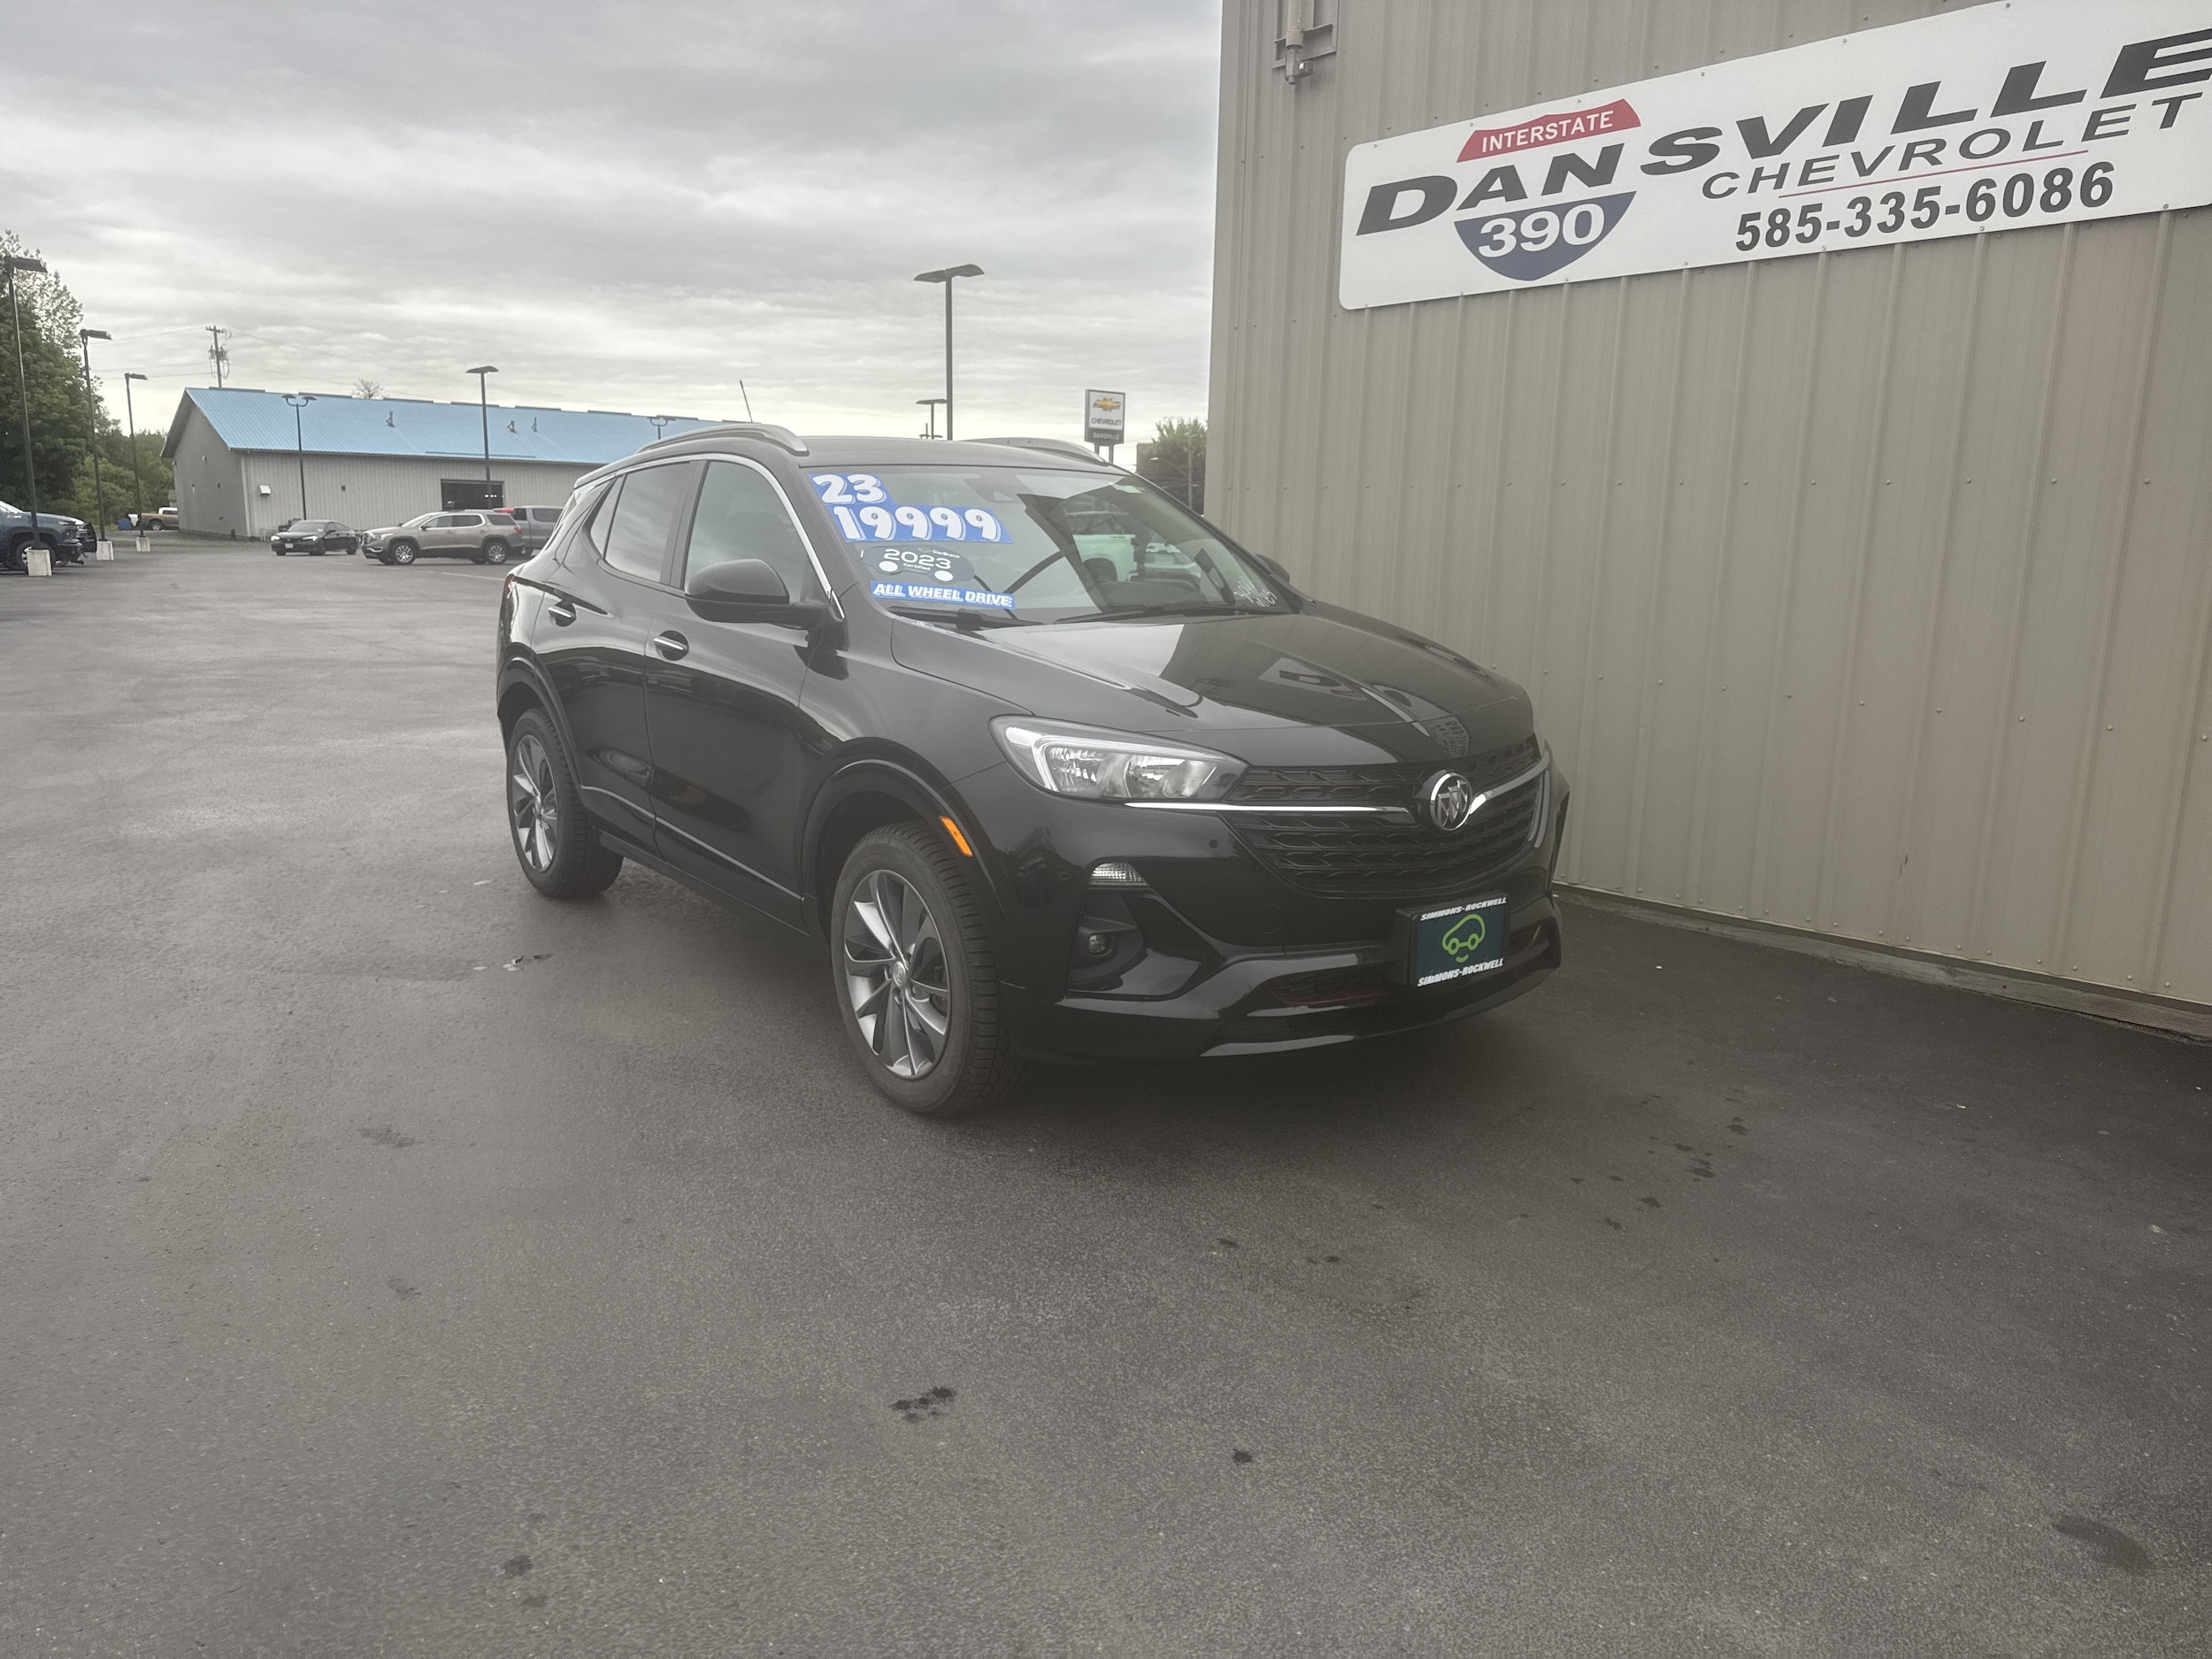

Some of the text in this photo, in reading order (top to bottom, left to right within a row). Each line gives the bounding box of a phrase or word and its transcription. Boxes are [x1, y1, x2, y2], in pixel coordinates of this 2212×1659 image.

[1481, 111, 1614, 153] INTERSTATE
[1701, 92, 2203, 199] CHEVROLET
[1736, 161, 2116, 251] 585-335-6086
[1478, 203, 1605, 258] 390
[1091, 417, 1122, 426] CHEVROLET
[812, 473, 887, 504] 23
[833, 505, 1002, 542] 19999
[884, 549, 951, 570] 2023
[902, 562, 931, 572] Certified
[872, 583, 1013, 608] ALL WHEEL DRIVE
[1420, 896, 1507, 921] SIMMONS-ROCKWELL
[1417, 957, 1504, 987] SIMMONS-ROCKWELL
